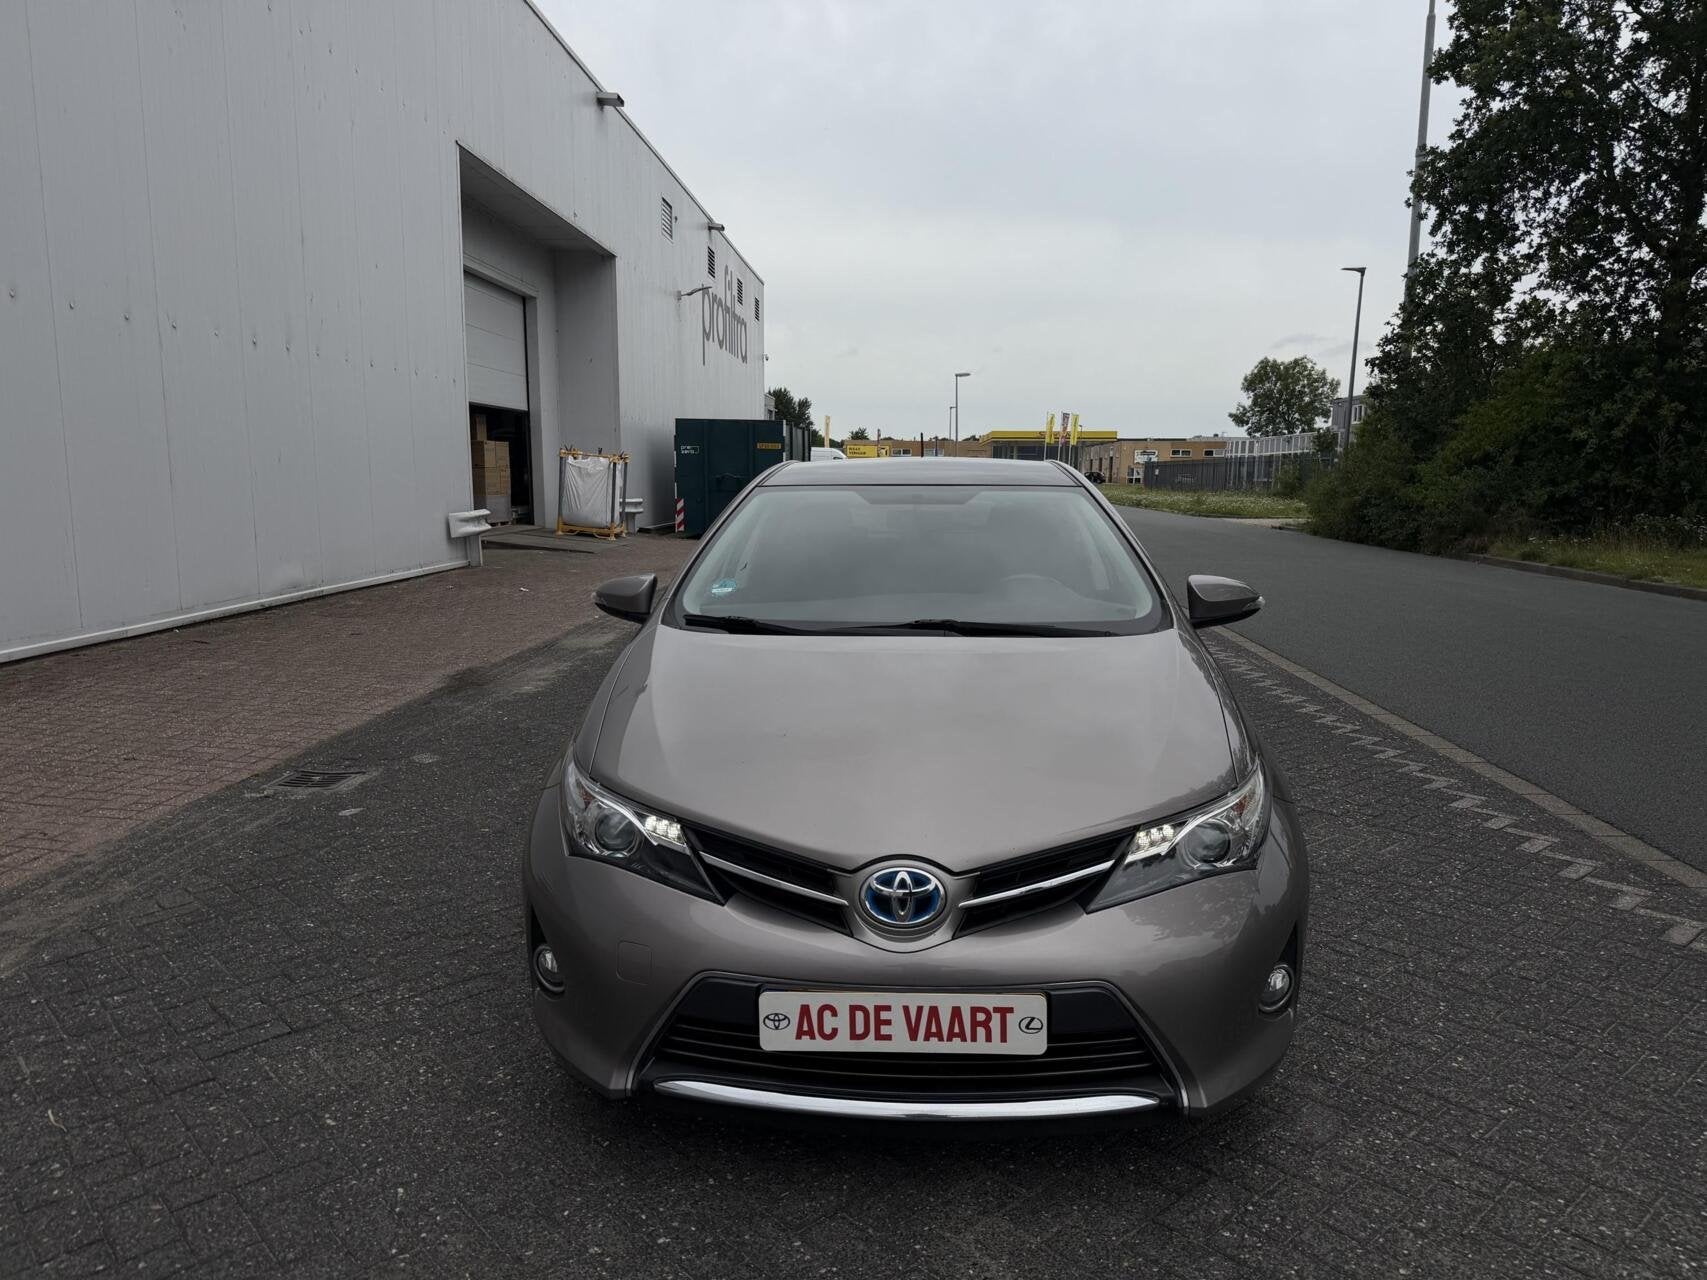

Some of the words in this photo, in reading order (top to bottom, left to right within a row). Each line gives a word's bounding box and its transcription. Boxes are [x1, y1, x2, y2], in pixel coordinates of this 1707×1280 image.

[795, 1003, 839, 1041] AC
[848, 1004, 893, 1042] DE
[902, 1005, 1014, 1044] VAART
